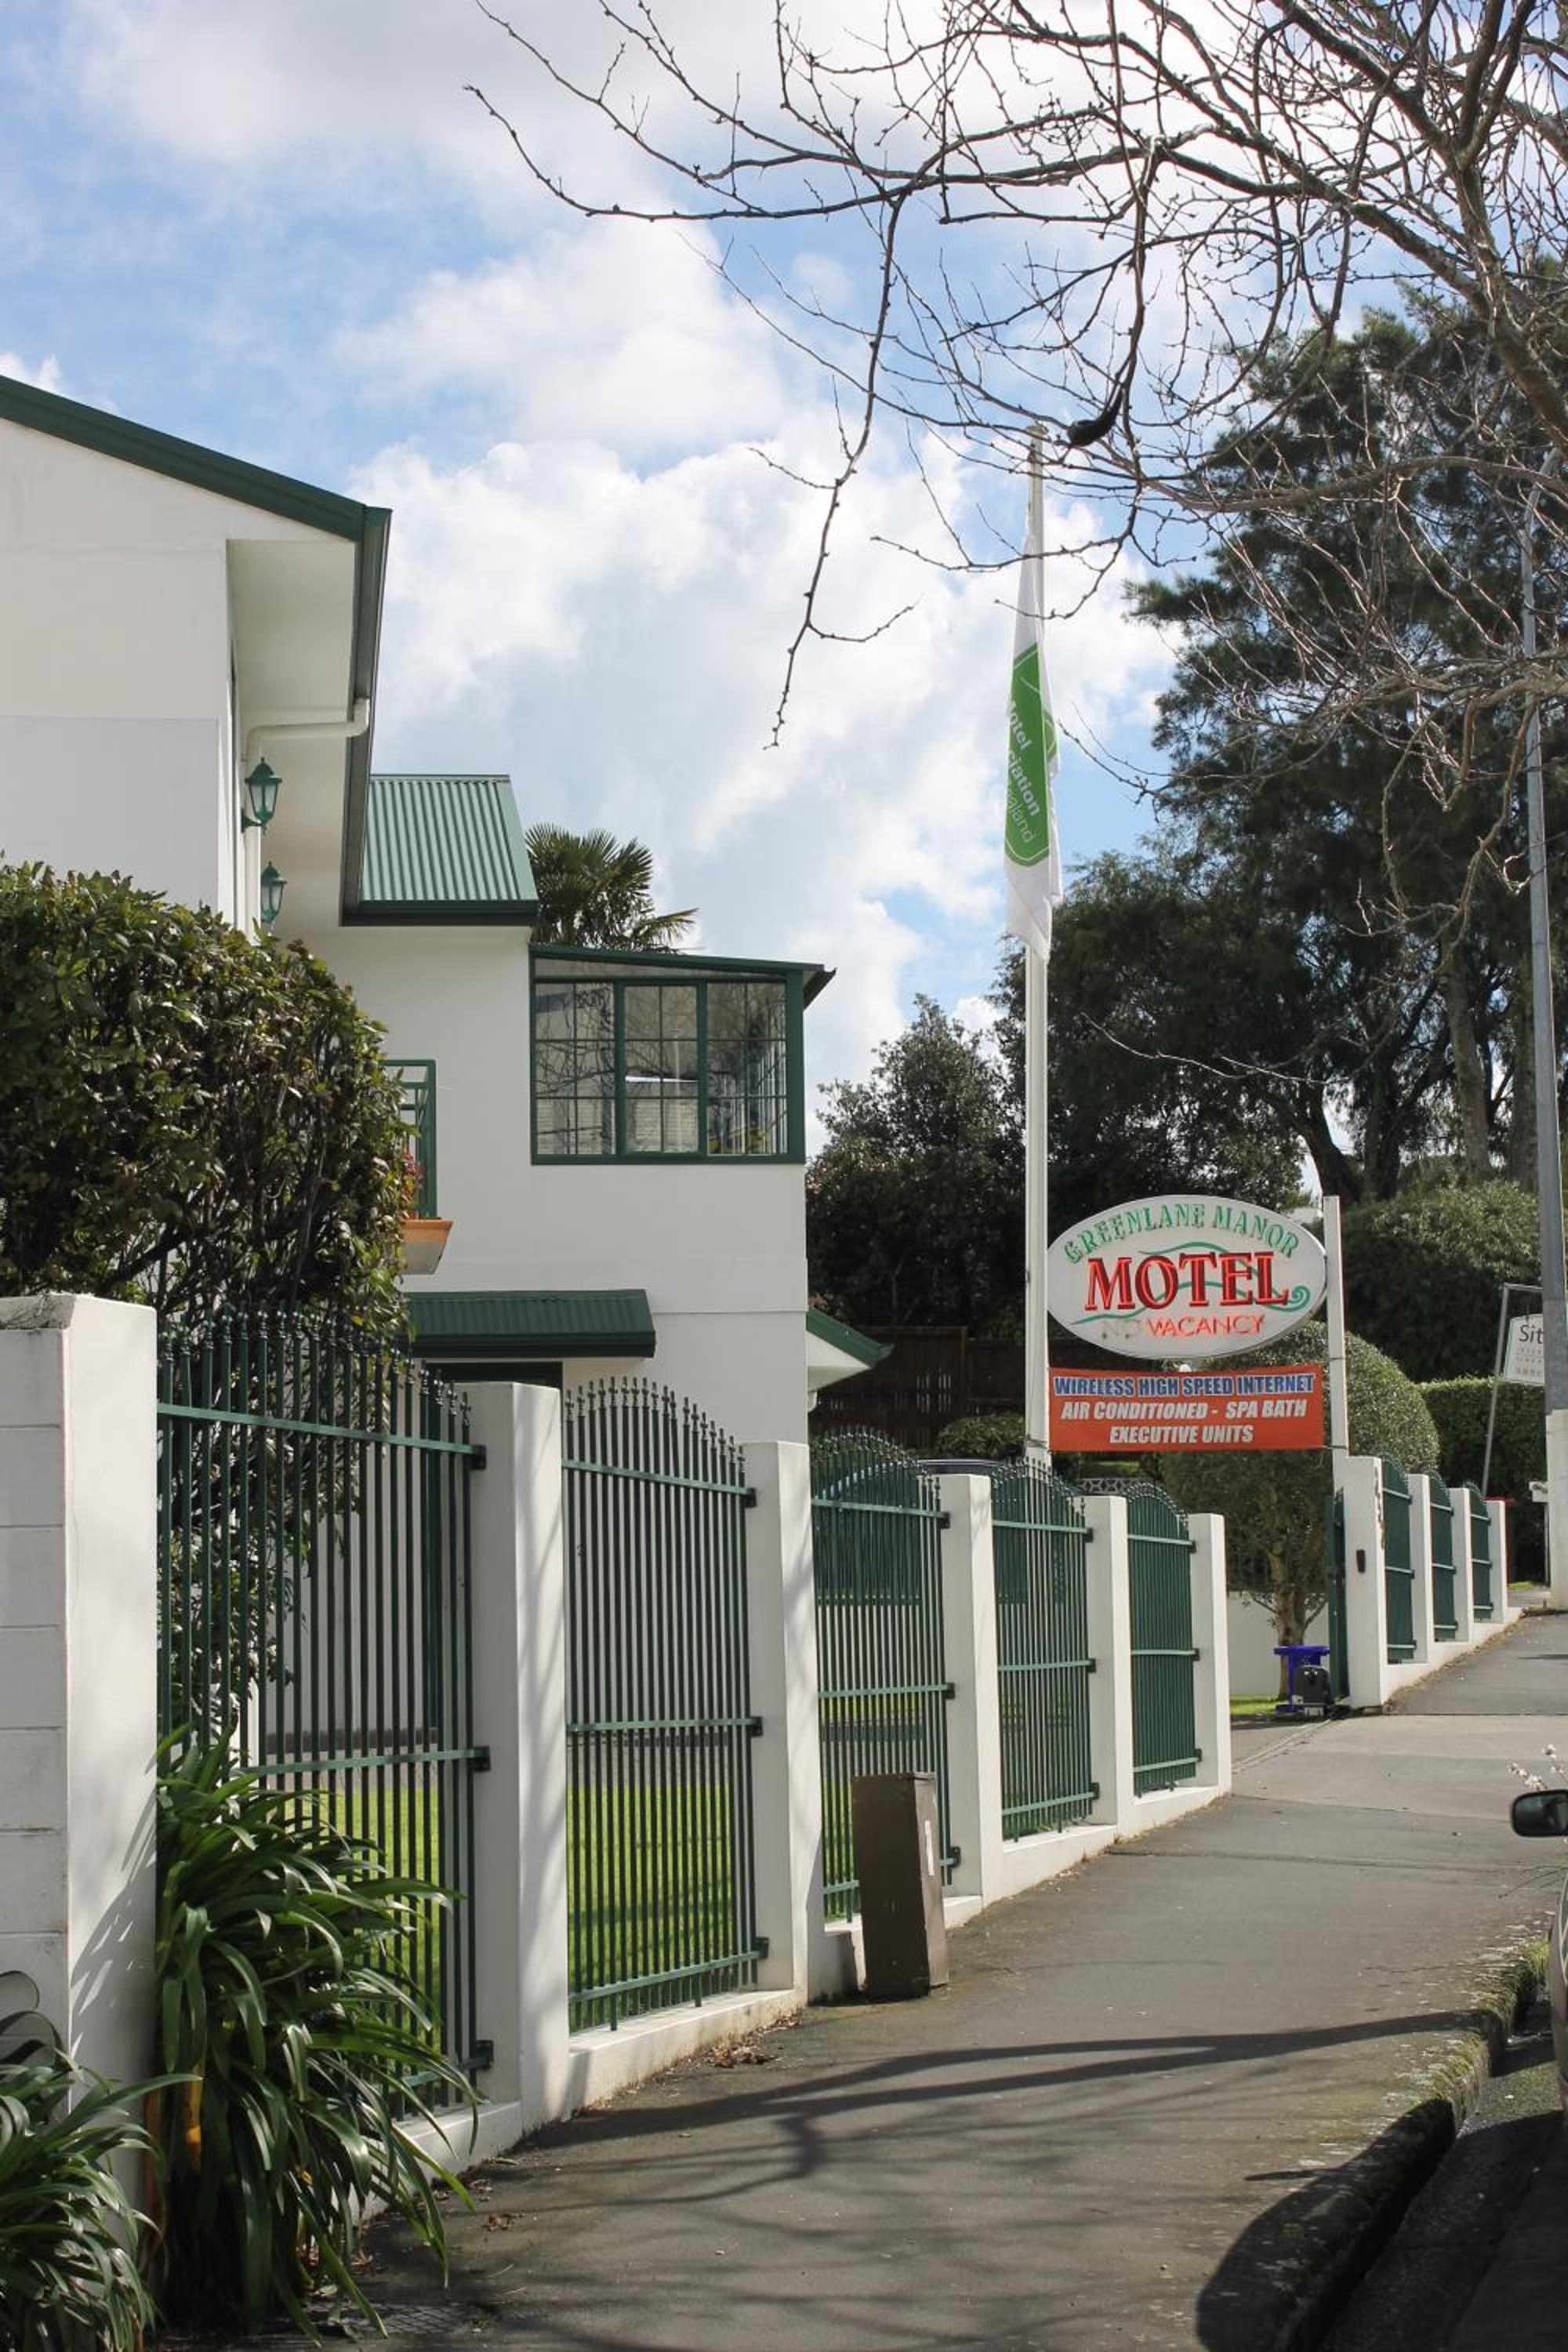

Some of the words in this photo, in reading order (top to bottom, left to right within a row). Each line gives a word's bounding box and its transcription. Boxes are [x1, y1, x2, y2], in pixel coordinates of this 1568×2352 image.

[1007, 750, 1040, 816] ciation
[1064, 1203, 1205, 1264] GREENLANE
[1213, 1205, 1299, 1258] MANOR
[1085, 1251, 1289, 1310] MOTEL
[1148, 1314, 1265, 1338] VACANCY
[1518, 1324, 1543, 1345] Sit
[1054, 1377, 1135, 1396] WIRELESS
[1139, 1377, 1178, 1396] HIGH
[1182, 1377, 1233, 1396] SPEED
[1236, 1374, 1315, 1395] INTERNET
[1062, 1402, 1091, 1420] AIR
[1094, 1402, 1208, 1420] CONDITIONED
[1225, 1401, 1258, 1418] SPA
[1262, 1399, 1307, 1417] BATH
[1109, 1425, 1199, 1443] EXECUTIVE
[1202, 1425, 1254, 1443] UNITS
